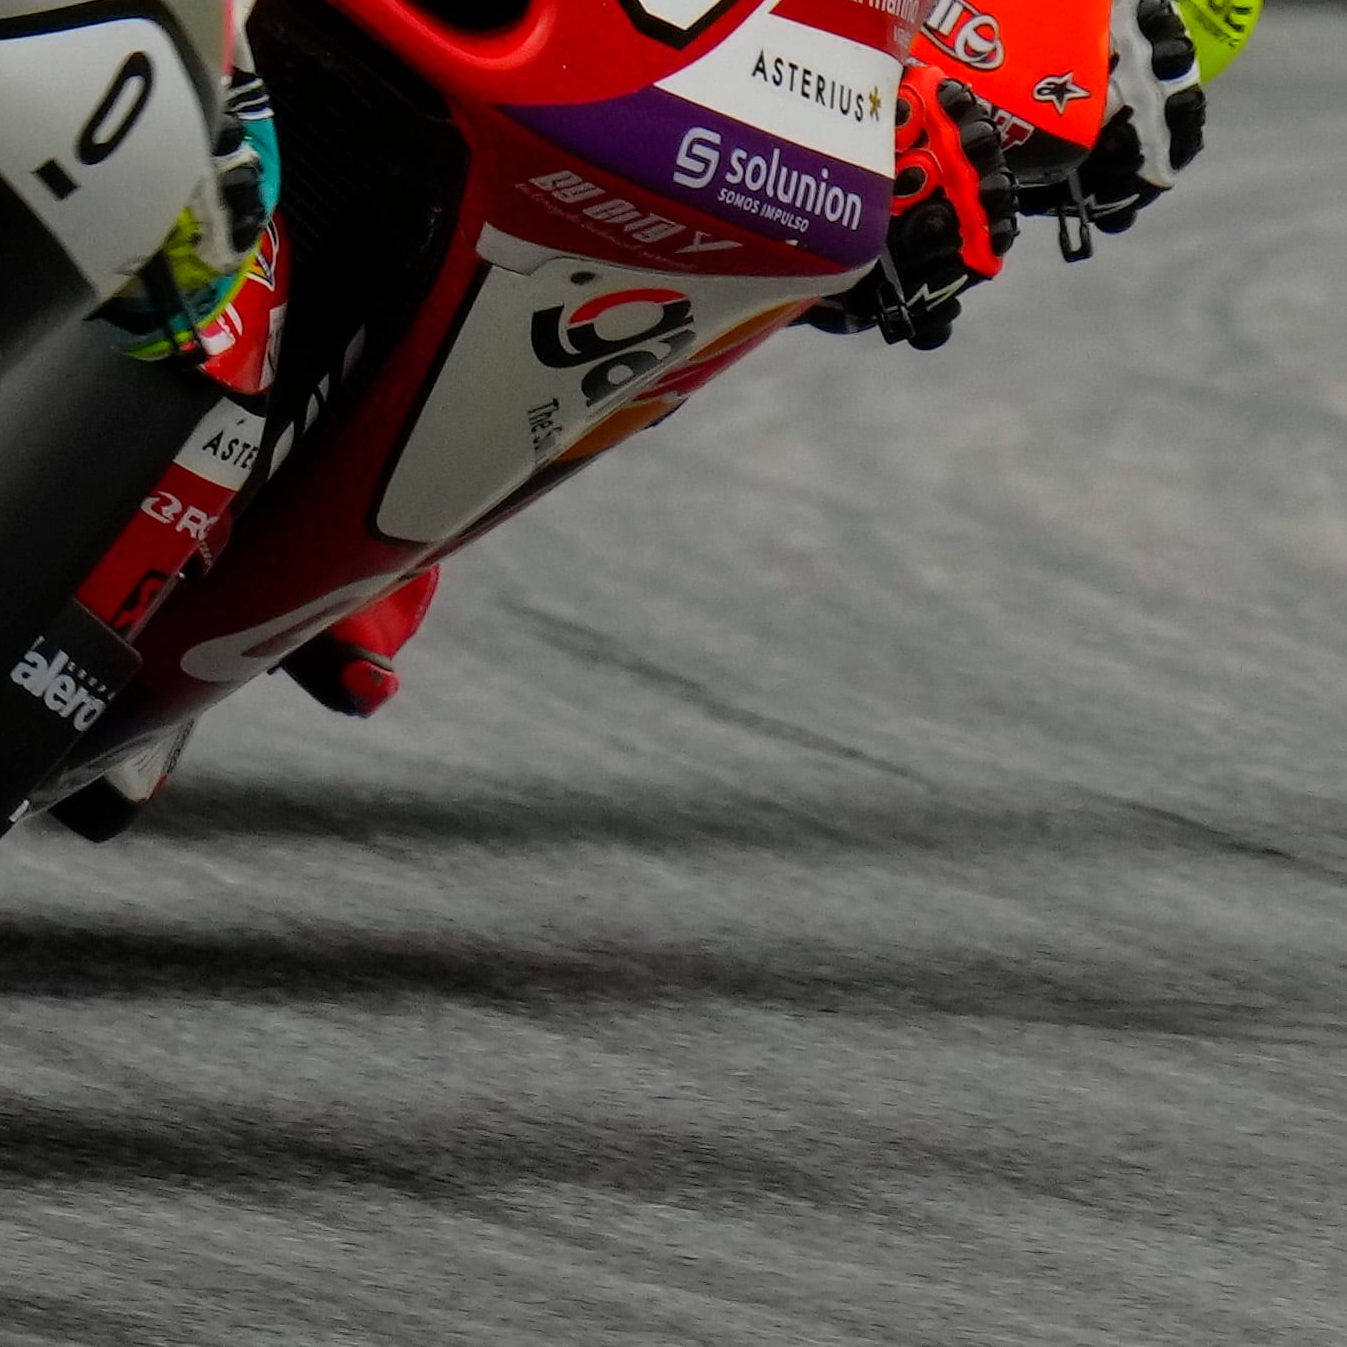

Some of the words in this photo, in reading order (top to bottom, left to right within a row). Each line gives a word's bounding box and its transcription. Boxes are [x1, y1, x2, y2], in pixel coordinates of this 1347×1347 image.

[751, 48, 868, 124] ASTERIUS
[716, 186, 761, 215] SOMOS
[758, 202, 811, 235] IMPULSO
[724, 147, 864, 233] solunion
